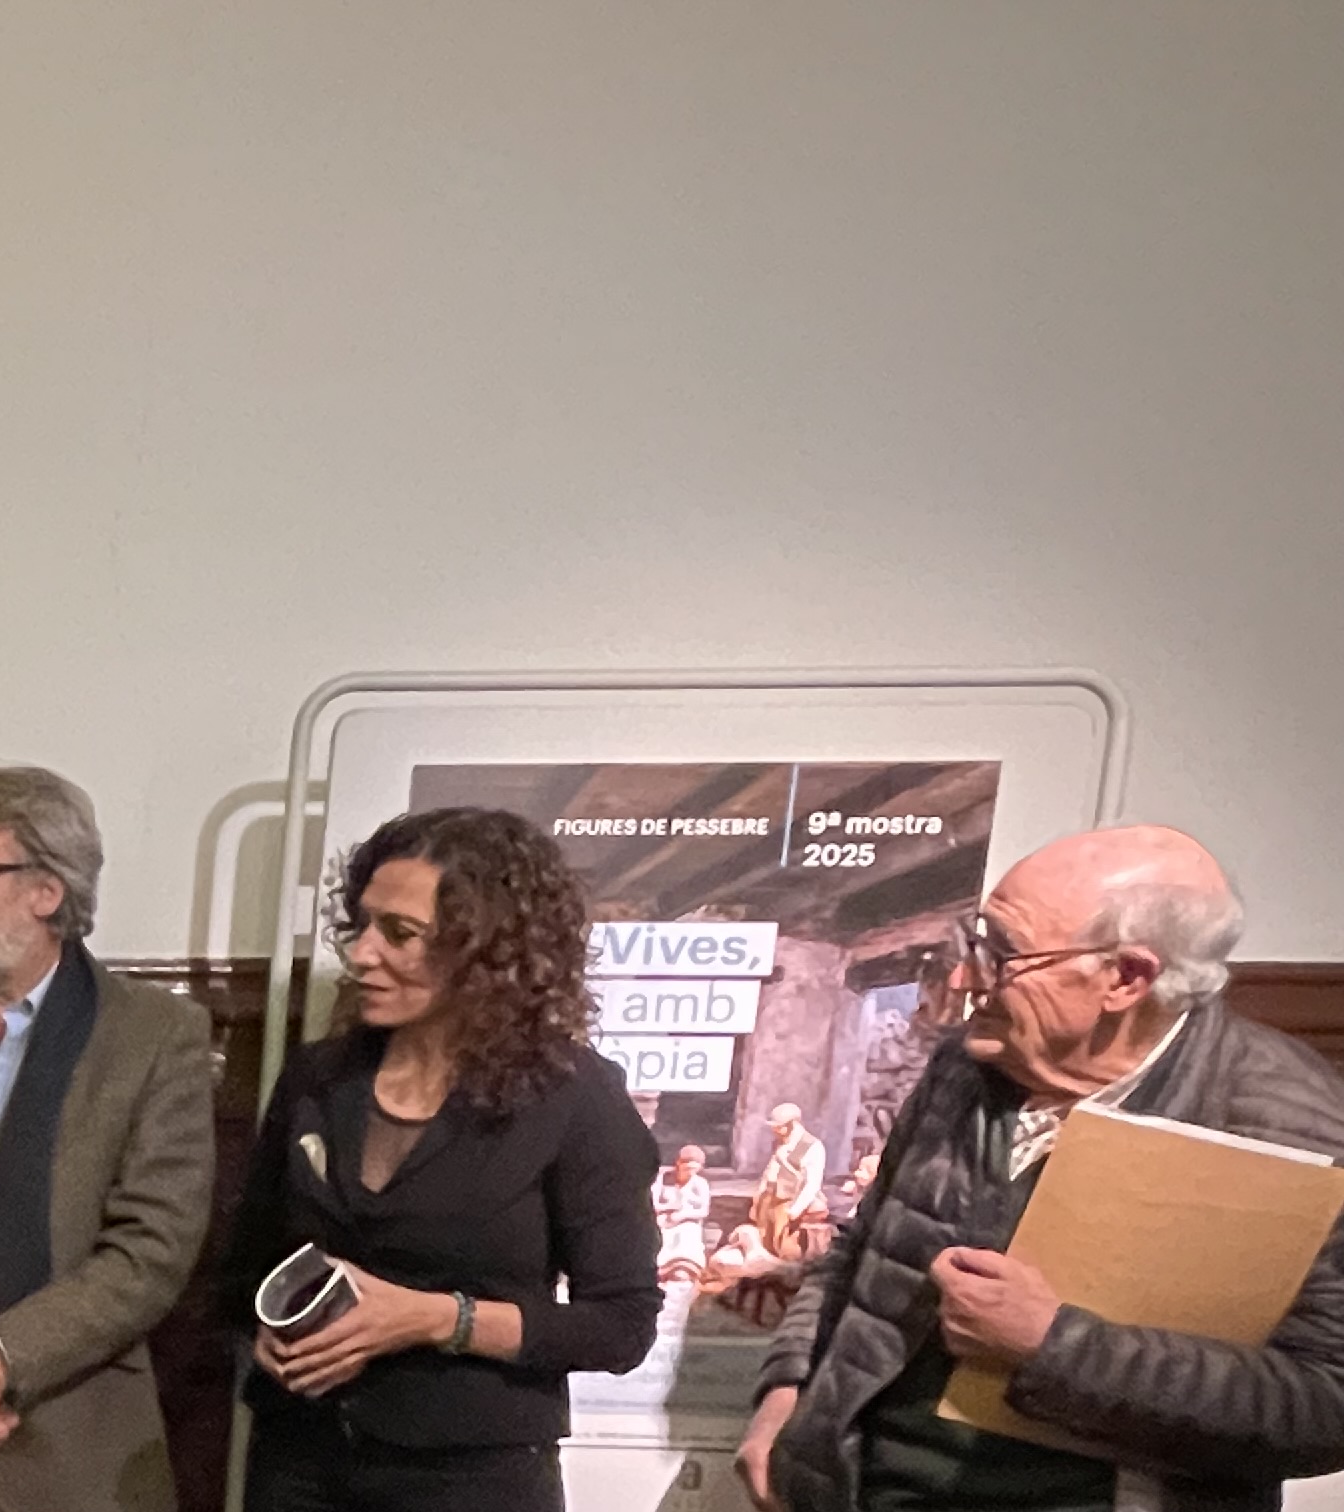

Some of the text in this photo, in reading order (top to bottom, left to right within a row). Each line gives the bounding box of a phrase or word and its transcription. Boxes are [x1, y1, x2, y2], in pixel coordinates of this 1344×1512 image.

[553, 818, 770, 836] FIGURES DE PESSEBRE
[844, 813, 944, 836] mostra
[802, 842, 877, 868] 2025
[621, 981, 736, 1024] amb
[608, 1038, 709, 1088] òpia
